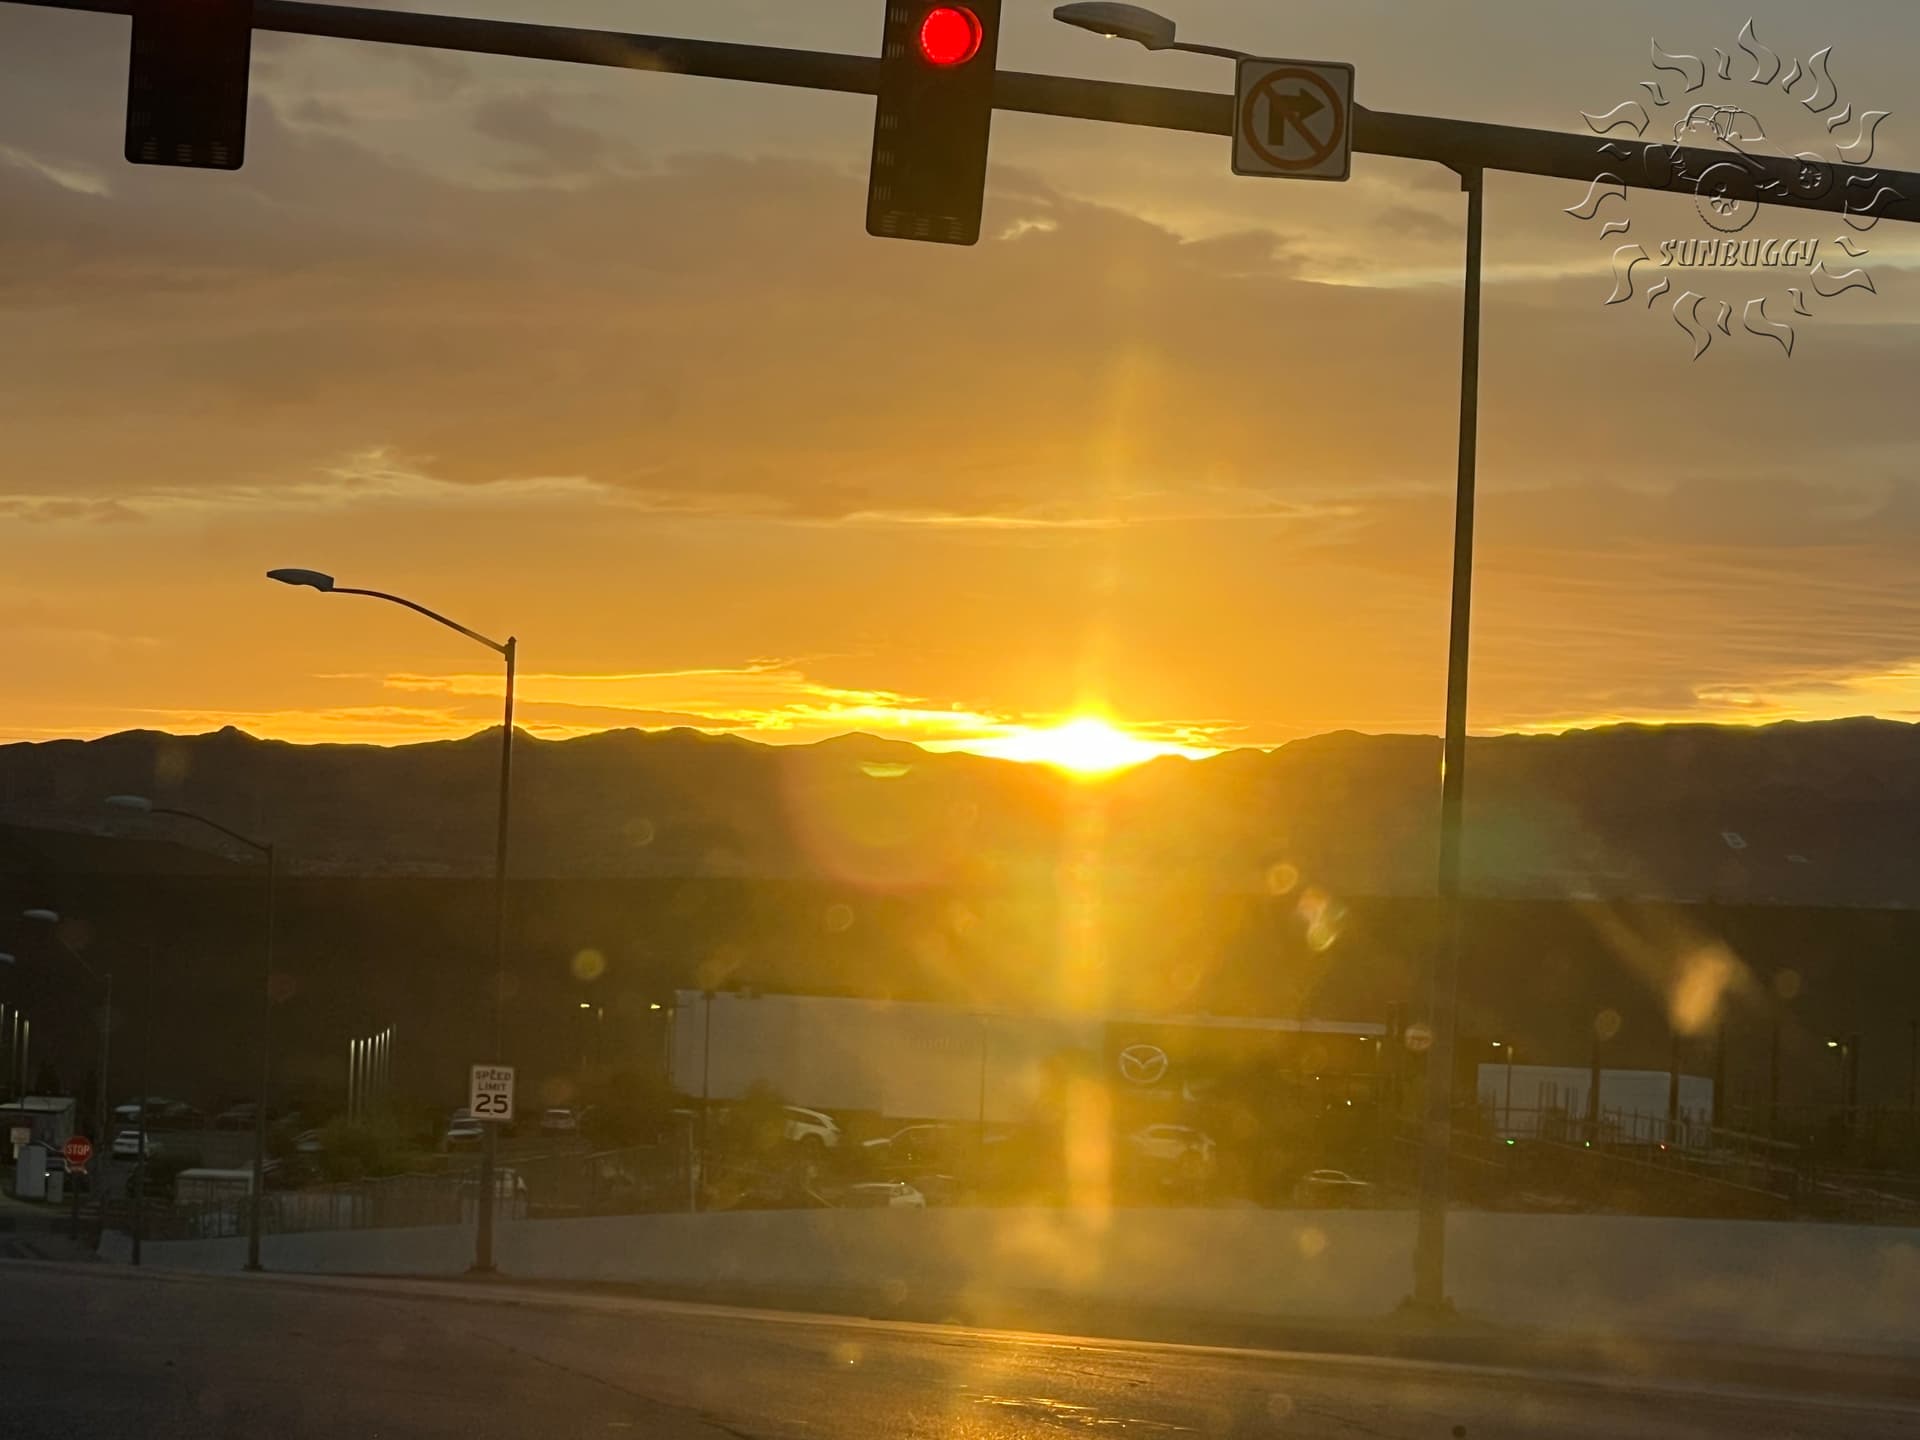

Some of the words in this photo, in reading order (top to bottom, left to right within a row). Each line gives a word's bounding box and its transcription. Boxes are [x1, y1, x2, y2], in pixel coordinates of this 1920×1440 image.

[475, 1069, 511, 1081] SPEED
[478, 1082, 507, 1091] LIMIT
[475, 1093, 508, 1114] 25
[67, 1144, 90, 1156] STOP
